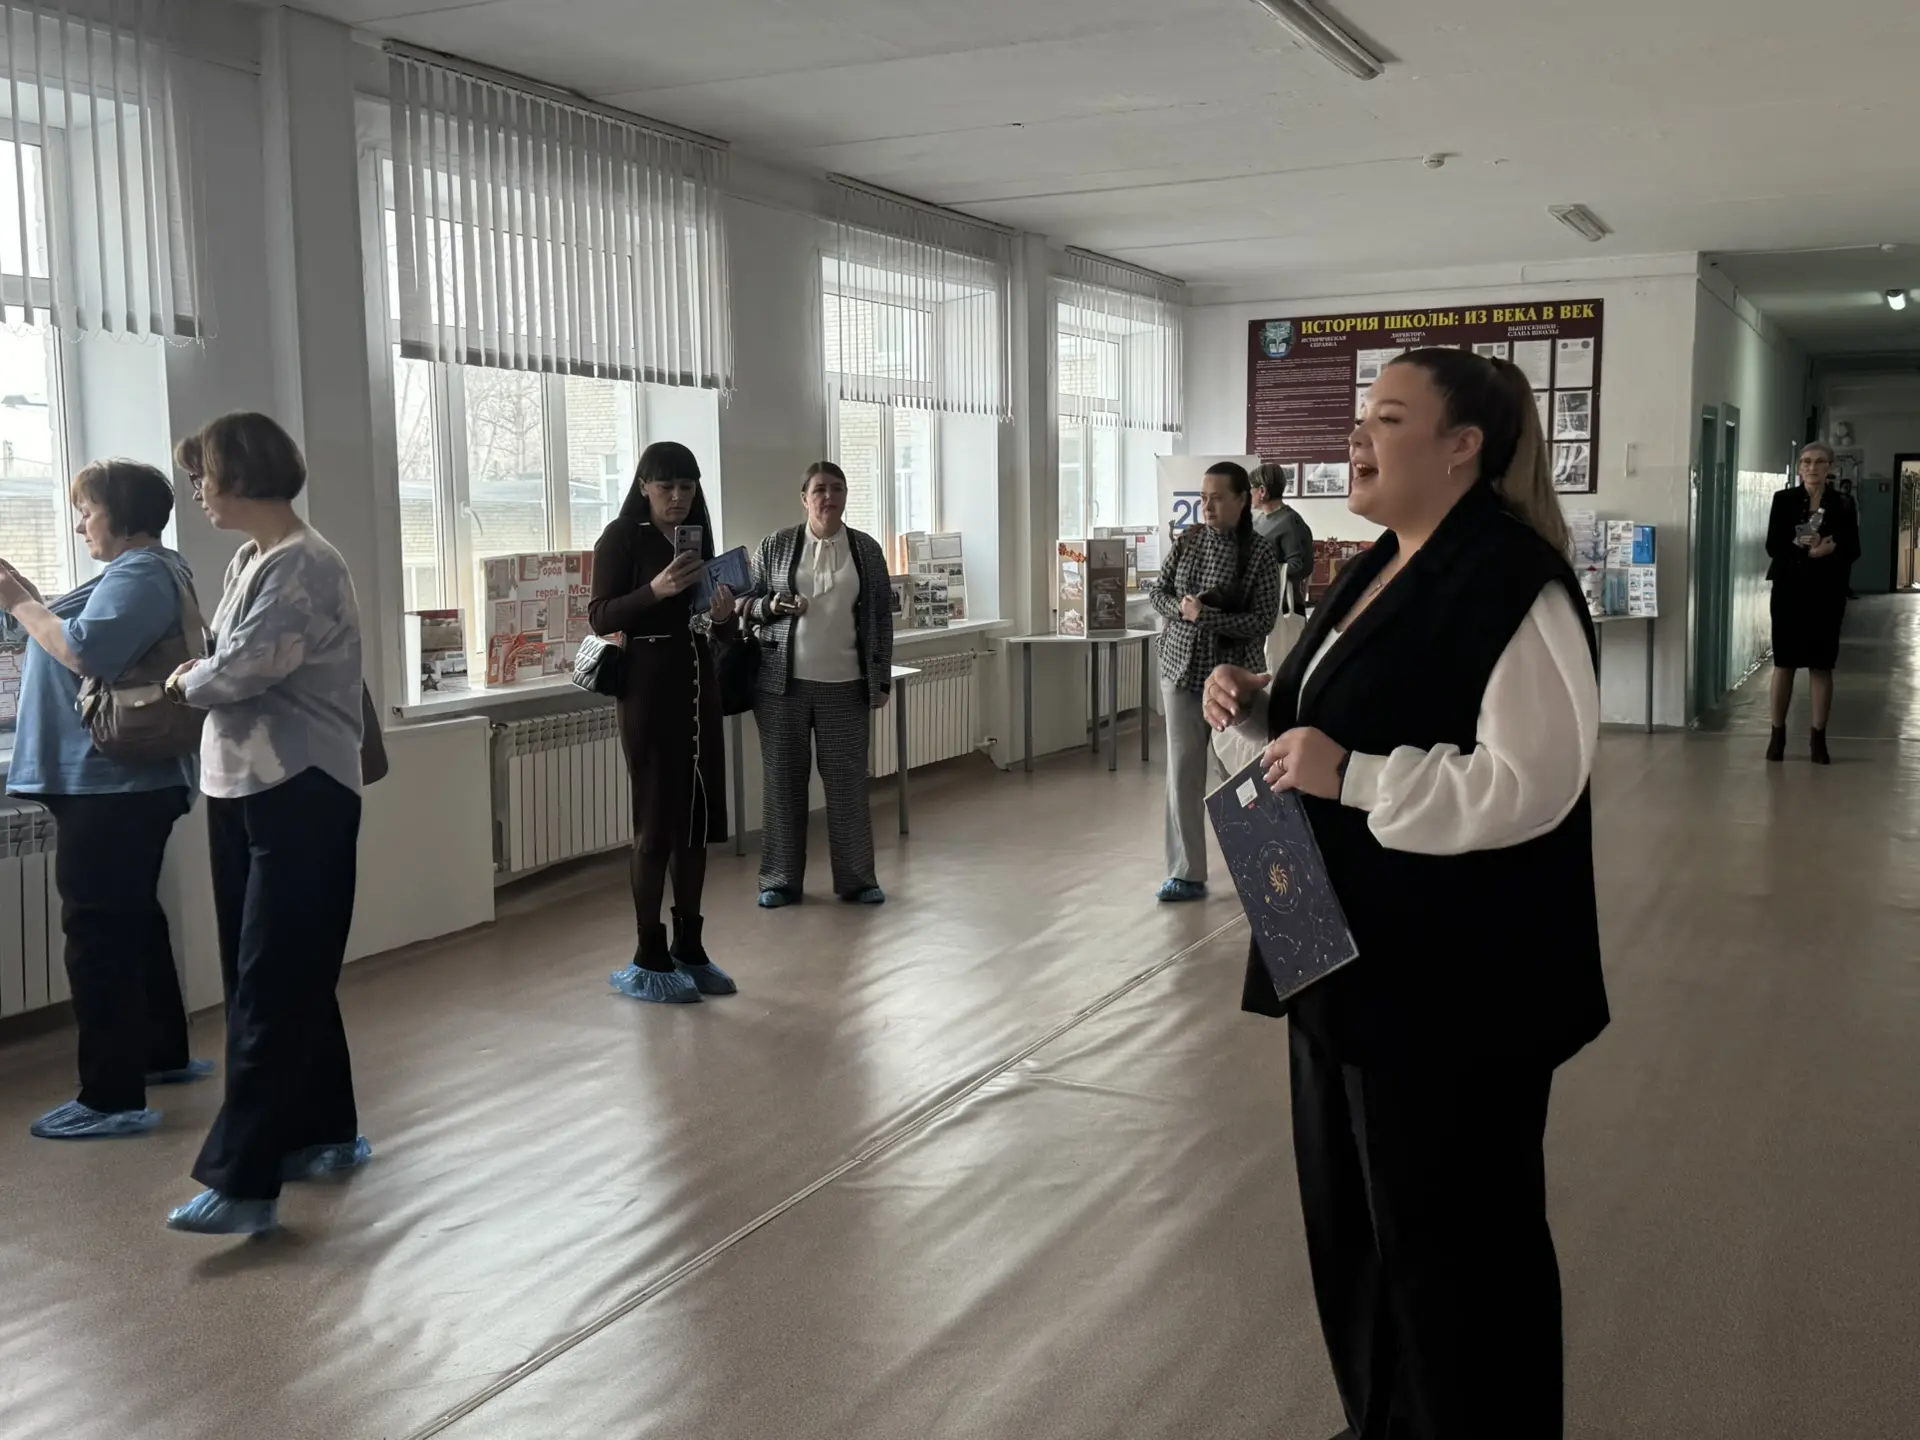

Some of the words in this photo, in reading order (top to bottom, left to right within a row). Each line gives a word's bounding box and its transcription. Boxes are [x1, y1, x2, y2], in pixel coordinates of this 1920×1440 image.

[1301, 317, 1379, 334] ИСТОРИЯ
[1384, 313, 1459, 330] ШКОЛЫ:
[1465, 309, 1488, 325] ИЗ
[1493, 307, 1537, 323] ВЕКА
[1542, 305, 1554, 320] В
[1560, 303, 1595, 319] ВЕК
[1301, 335, 1347, 343] ИСТОРИЧЕСКАЯ
[1391, 331, 1426, 339] ДИРЕКТОРА
